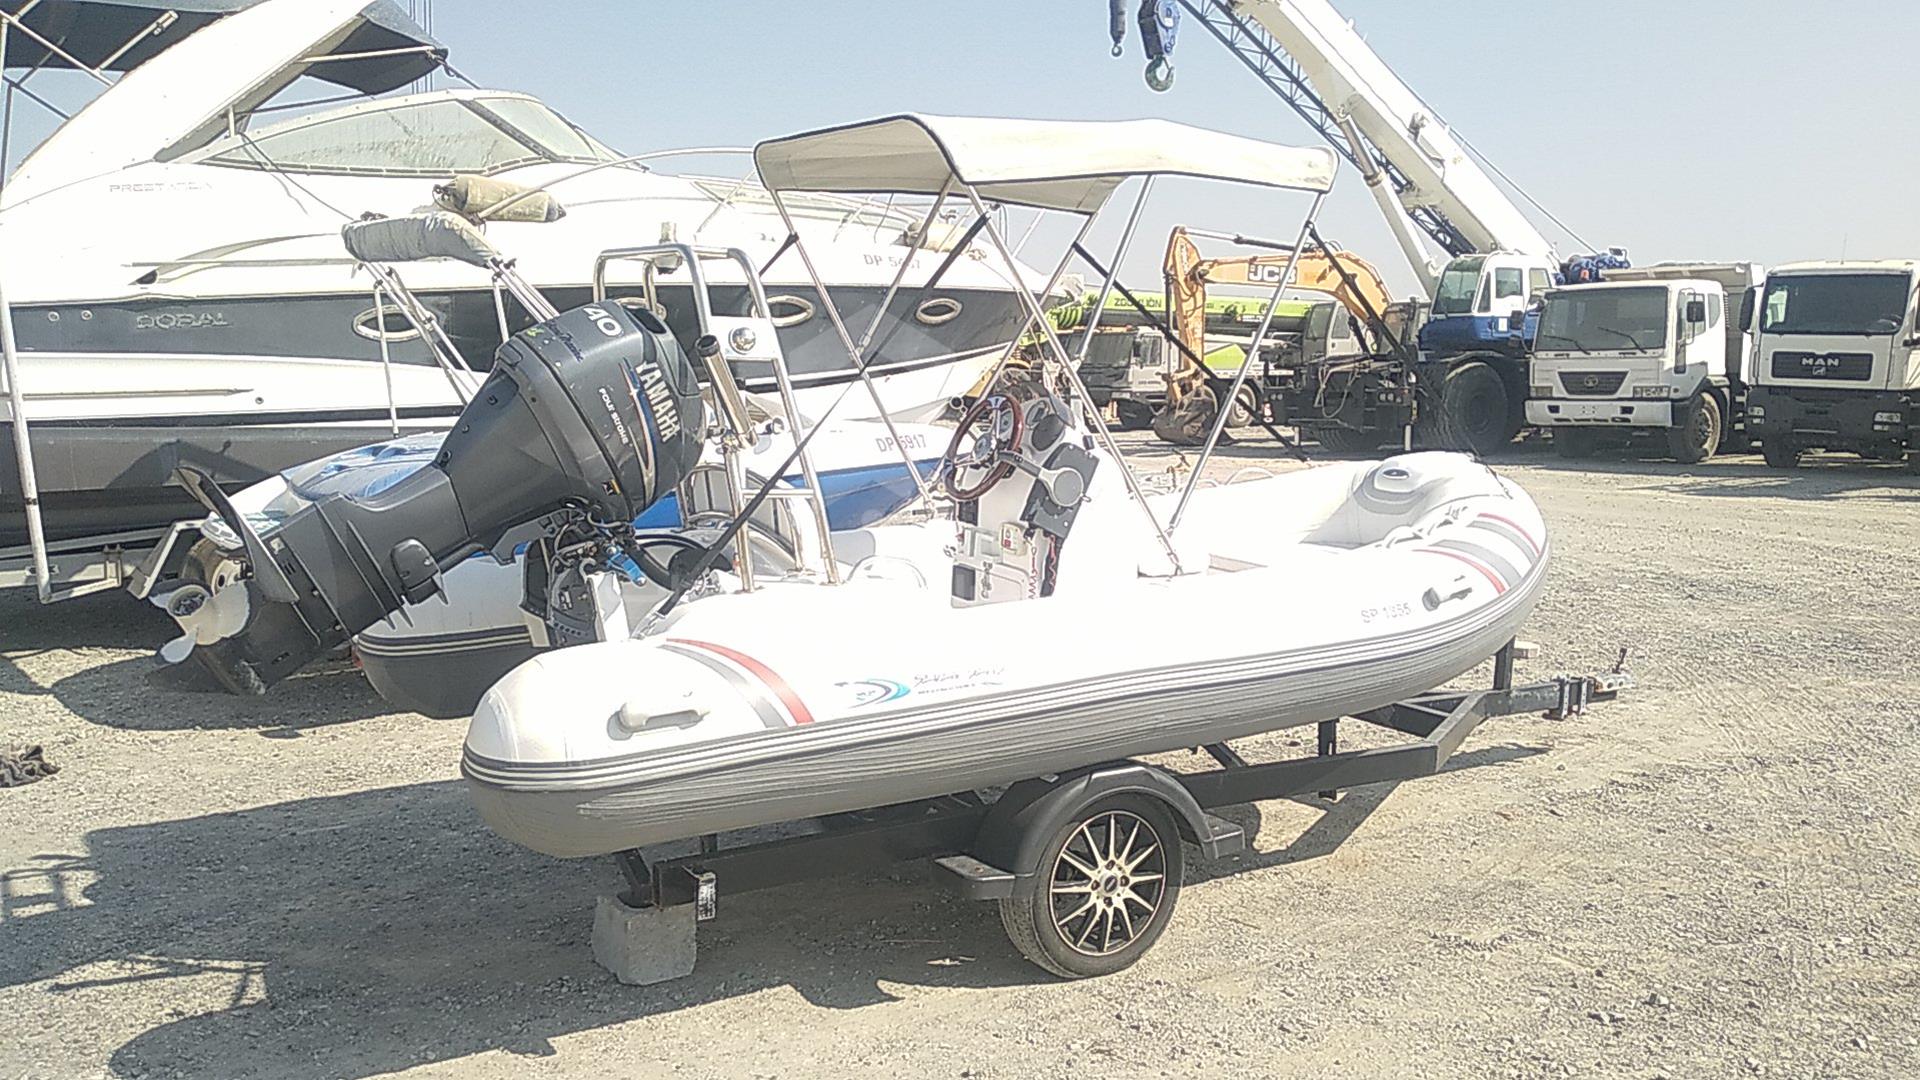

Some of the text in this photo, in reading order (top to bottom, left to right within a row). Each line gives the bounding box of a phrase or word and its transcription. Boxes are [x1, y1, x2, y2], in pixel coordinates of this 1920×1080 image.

[863, 254, 883, 266] DP
[136, 312, 229, 329] DORAL
[583, 306, 624, 336] 40
[1801, 357, 1839, 367] MAN
[635, 360, 681, 443] YAMAHA
[875, 434, 926, 452] DP 5917
